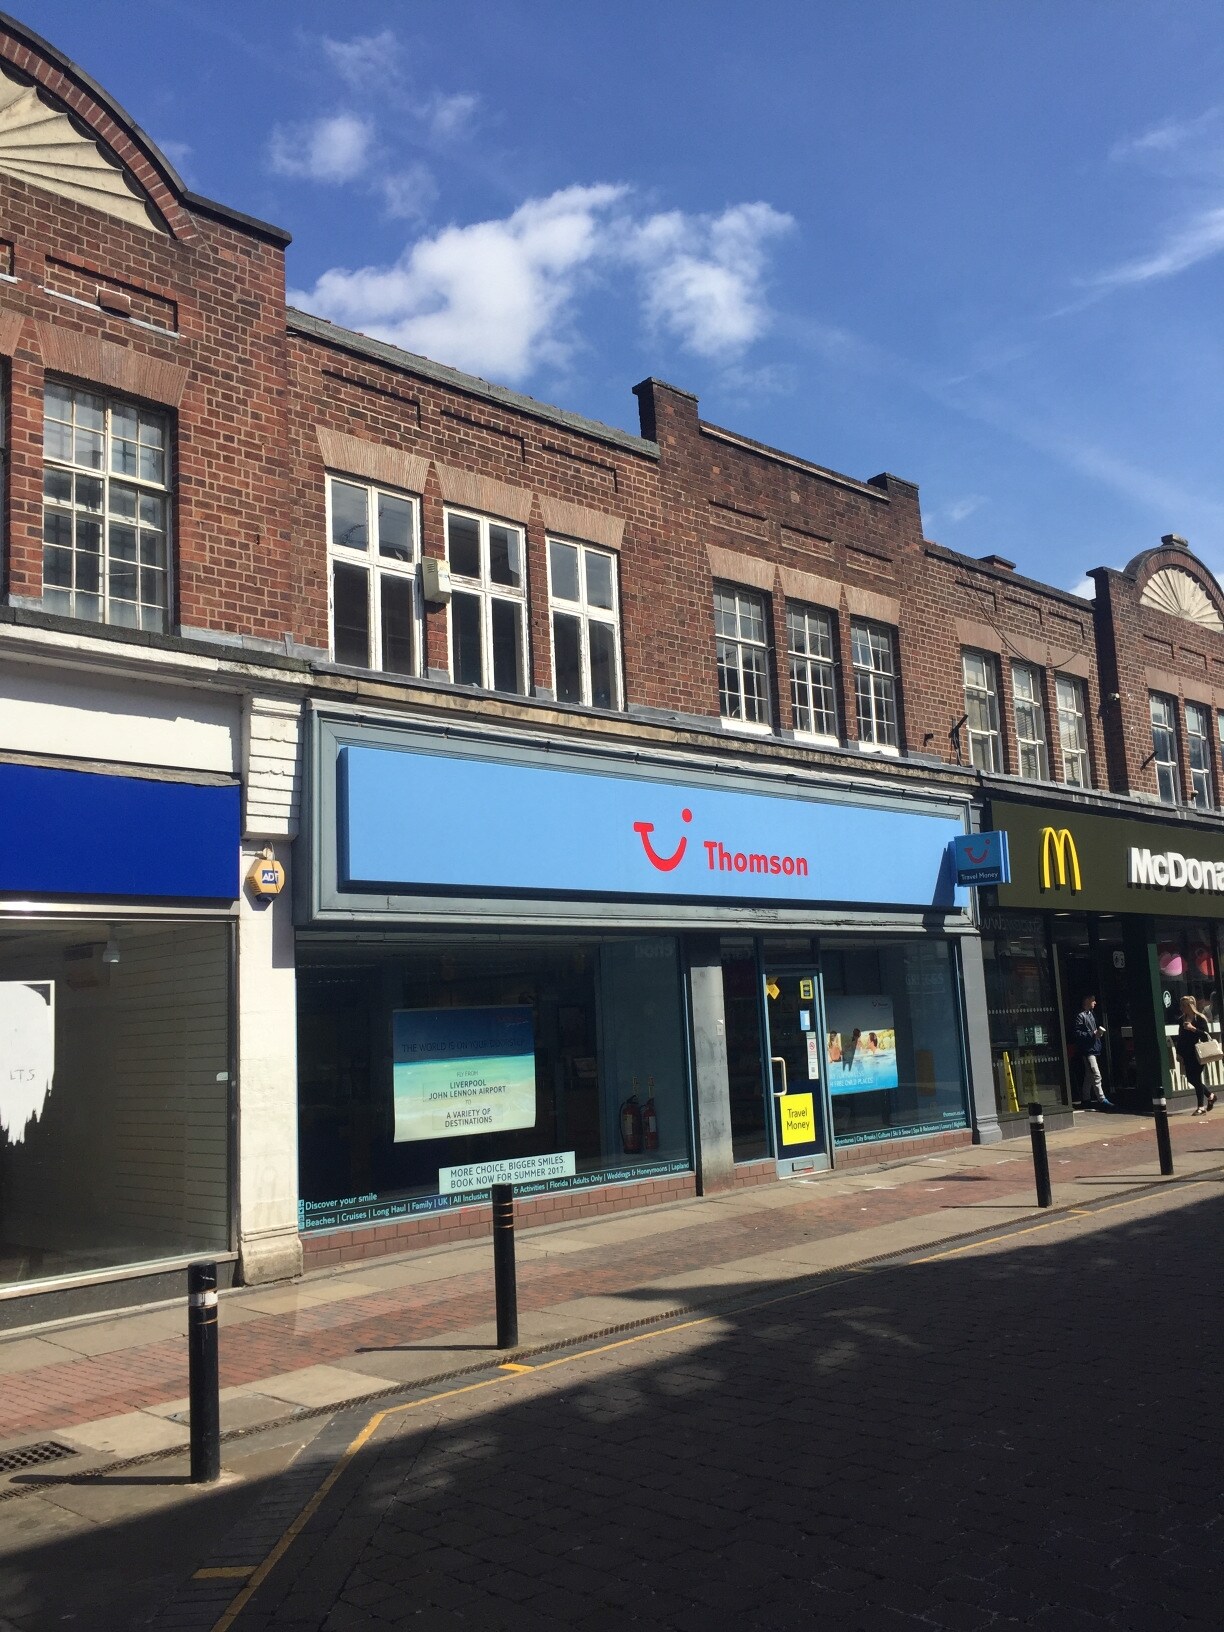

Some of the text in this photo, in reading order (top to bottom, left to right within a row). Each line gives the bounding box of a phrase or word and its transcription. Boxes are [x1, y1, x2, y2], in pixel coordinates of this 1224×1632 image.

[703, 840, 808, 876] Thomson
[262, 871, 279, 883] ADT
[402, 1044, 417, 1053] THE
[420, 1041, 447, 1052] WORLD
[449, 1041, 455, 1050] IS
[457, 1041, 467, 1049] ON
[449, 1079, 487, 1090] LIVERPOOL
[428, 1085, 507, 1101] JOHN LENNON AIRPORT
[452, 1109, 480, 1118] VARIETY
[481, 1107, 491, 1115] OF
[786, 1107, 811, 1131] Travel Money
[444, 1115, 493, 1128] DESTINATIONS
[877, 1131, 891, 1139] Culture
[450, 1155, 566, 1178] MORE CHOICE, BIGGER SMILES.
[450, 1165, 566, 1189] BOOK NOW FOR SUMMER 2017.
[305, 1162, 690, 1228] Beaches Cruises Long Haul Family UK All Inclusive & Activities Florida Adults Only Weddings & Honeymoons Lapland
[305, 1192, 378, 1211] Discover your smile
